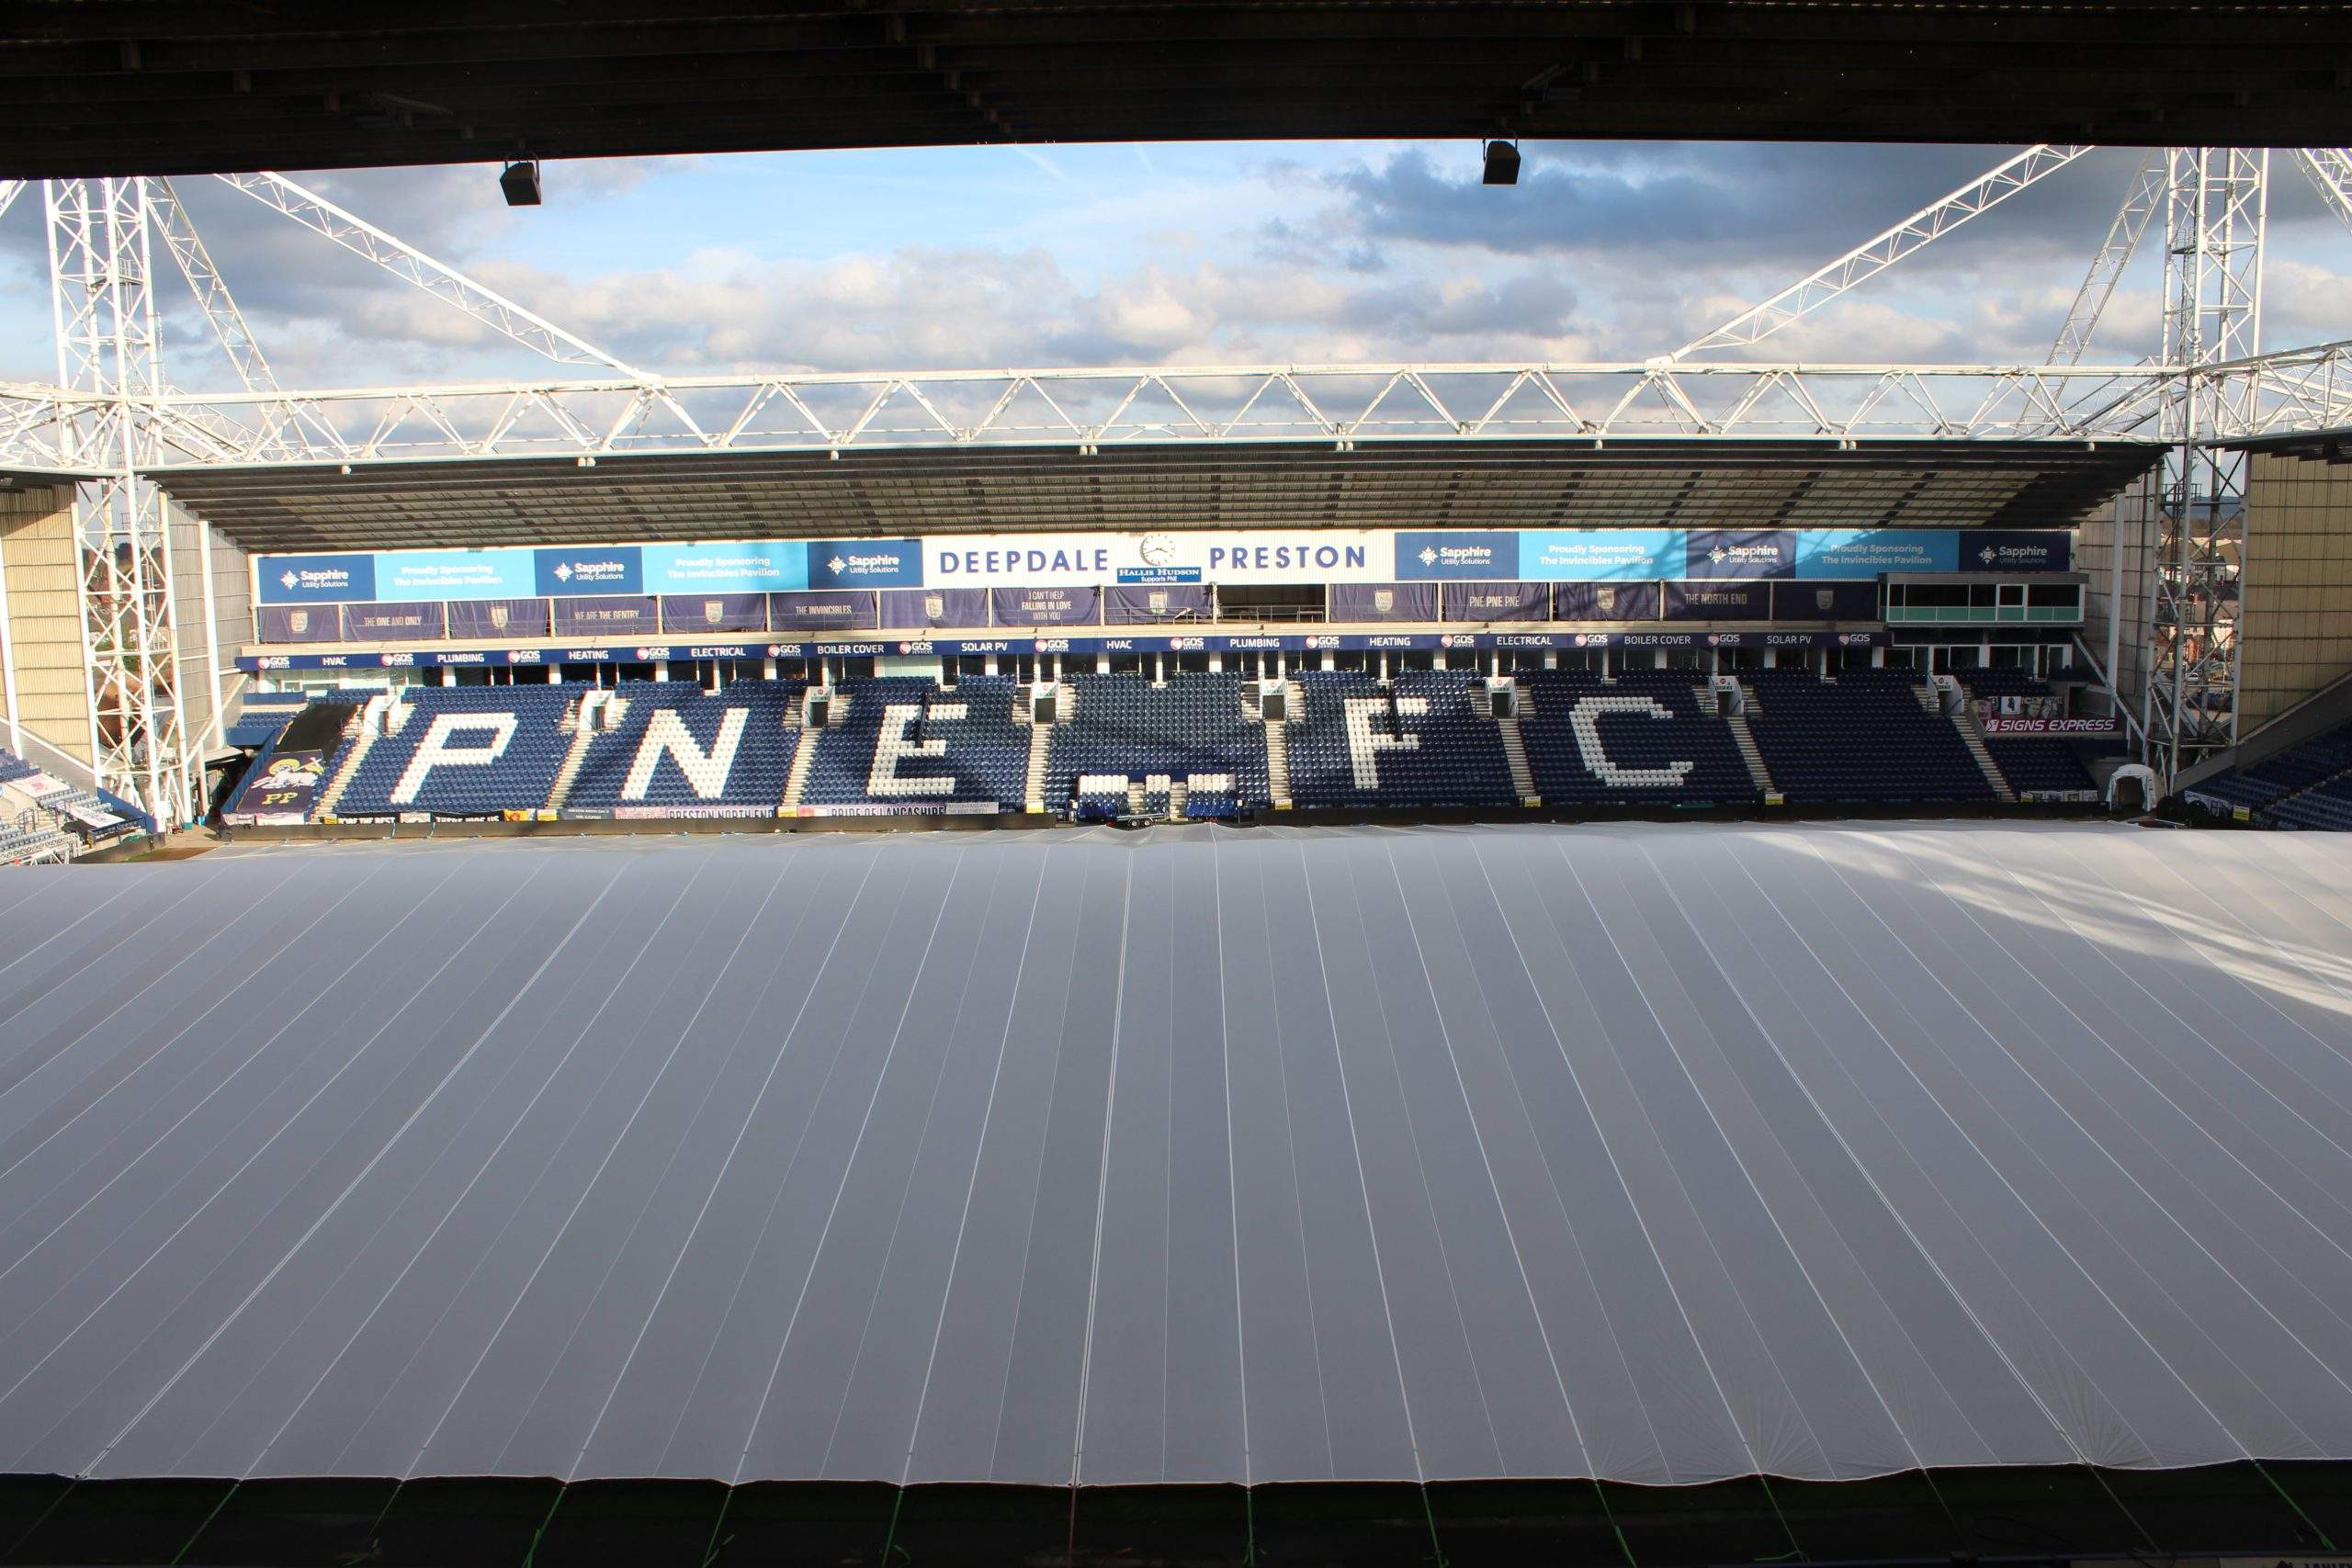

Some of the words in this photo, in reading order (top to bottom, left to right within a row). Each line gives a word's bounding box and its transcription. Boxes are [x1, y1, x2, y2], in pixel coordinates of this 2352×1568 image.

[1440, 546, 1492, 558] Sapphire
[1549, 545, 1587, 555] Proudly
[1589, 545, 1646, 555] Sponsoring
[1728, 545, 1779, 557] Sapphire
[1830, 544, 1867, 555] Proudly
[1870, 544, 1924, 555] Sponsoring
[1998, 546, 2048, 558] Sapphire
[848, 555, 899, 567] Sapphire
[940, 549, 1108, 573] DEEPDALE
[1209, 546, 1365, 570] PRESTON
[1540, 557, 1558, 565] The
[1614, 555, 1654, 564] Pavilion
[1822, 556, 1838, 564] The
[1840, 555, 1893, 564] Invincibles
[1894, 555, 1932, 565] Pavilion
[574, 561, 625, 573] Sapphire
[300, 570, 349, 581] Sapphire
[321, 580, 348, 588] Solutions
[1049, 591, 1064, 599] HELP
[1684, 593, 1699, 604] THE
[1701, 593, 1729, 604] NORTH
[1731, 593, 1747, 604] END
[1022, 602, 1046, 610] FALLING
[1047, 602, 1055, 610] IN
[1056, 601, 1072, 610] LOVE
[1470, 596, 1484, 607] PNE
[1486, 596, 1503, 607] PNE
[1505, 595, 1520, 607] PNE
[574, 611, 585, 620] WE
[586, 611, 597, 620] ARE
[599, 610, 612, 619] THE
[613, 610, 639, 619] GENTRY
[796, 606, 808, 615] THE
[808, 605, 852, 615] INVINCIBLES
[364, 617, 376, 626] THE
[377, 616, 390, 626] ONE
[390, 616, 404, 626] AND
[405, 615, 422, 626] ONLY
[1033, 612, 1047, 621] WITH
[1048, 612, 1061, 621] YOU
[1182, 637, 1204, 646] GOS
[1230, 638, 1280, 648] PLUMBING
[1317, 636, 1340, 645] GOS
[1369, 637, 1410, 647] HEATING
[1453, 635, 1475, 643] GOS
[1497, 636, 1553, 646] ELECTRICAL
[1588, 634, 1608, 643] GOS
[1624, 636, 1658, 645] BOILER
[1660, 636, 1690, 645] COVER
[1719, 634, 1740, 643] GOS
[1767, 635, 1796, 644] SOLAR
[1800, 635, 1813, 644] PV
[1849, 634, 1871, 643] GOS
[781, 645, 800, 653] GOS
[911, 642, 933, 650] GOS
[961, 643, 994, 652] SOLAR
[995, 642, 1008, 651] PV
[1106, 640, 1132, 649] HVAC
[520, 650, 540, 660] GOS
[569, 650, 608, 660] HEATING
[650, 648, 670, 656] GOS
[691, 648, 746, 657] ELECTRICAL
[818, 646, 851, 655] BOILER
[853, 645, 884, 654] COVER
[269, 657, 289, 665] GOS
[322, 657, 347, 666] HVAC
[392, 654, 413, 662] GOS
[435, 653, 484, 663] PLUMBING
[2000, 719, 2045, 731] SIGNS
[2049, 719, 2115, 731] EXPRESS
[261, 792, 299, 805] PP
